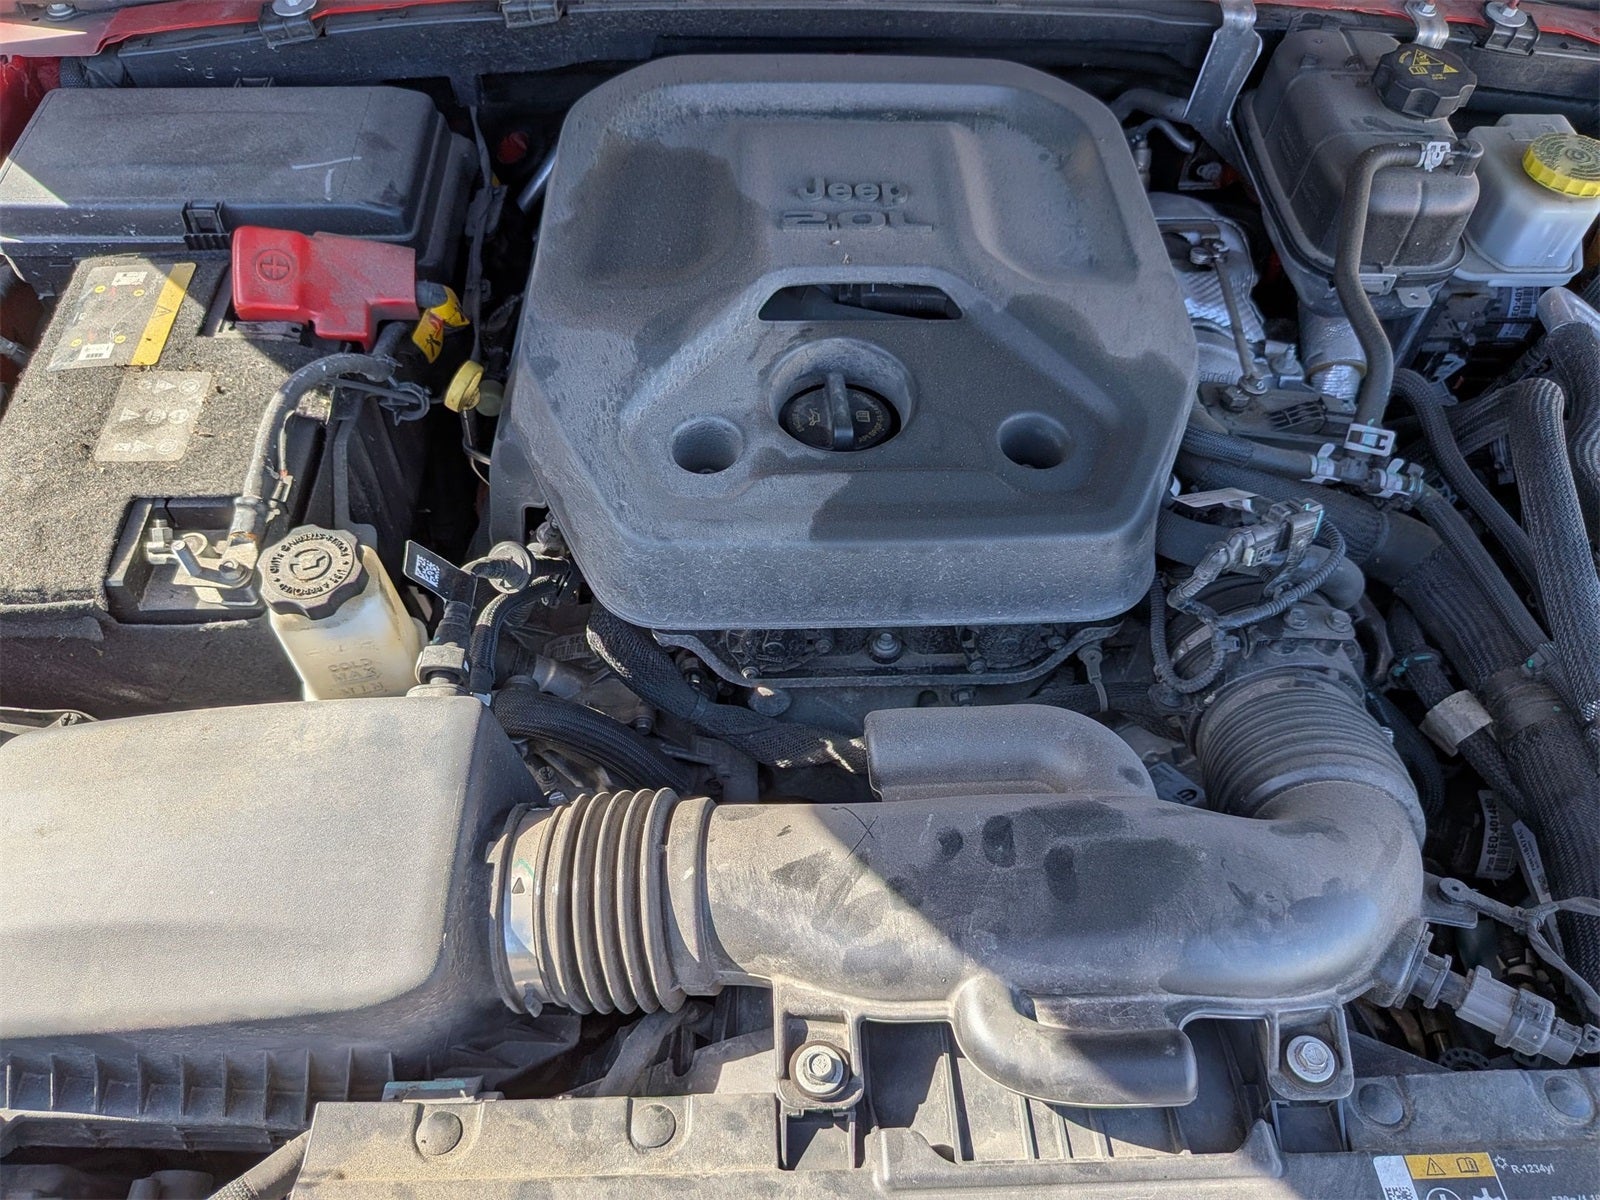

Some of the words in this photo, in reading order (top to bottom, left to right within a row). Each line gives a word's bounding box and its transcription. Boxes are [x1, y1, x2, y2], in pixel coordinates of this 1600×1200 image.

[798, 177, 908, 209] Jeep
[781, 211, 934, 232] 2.0L
[1199, 369, 1236, 383] arrett
